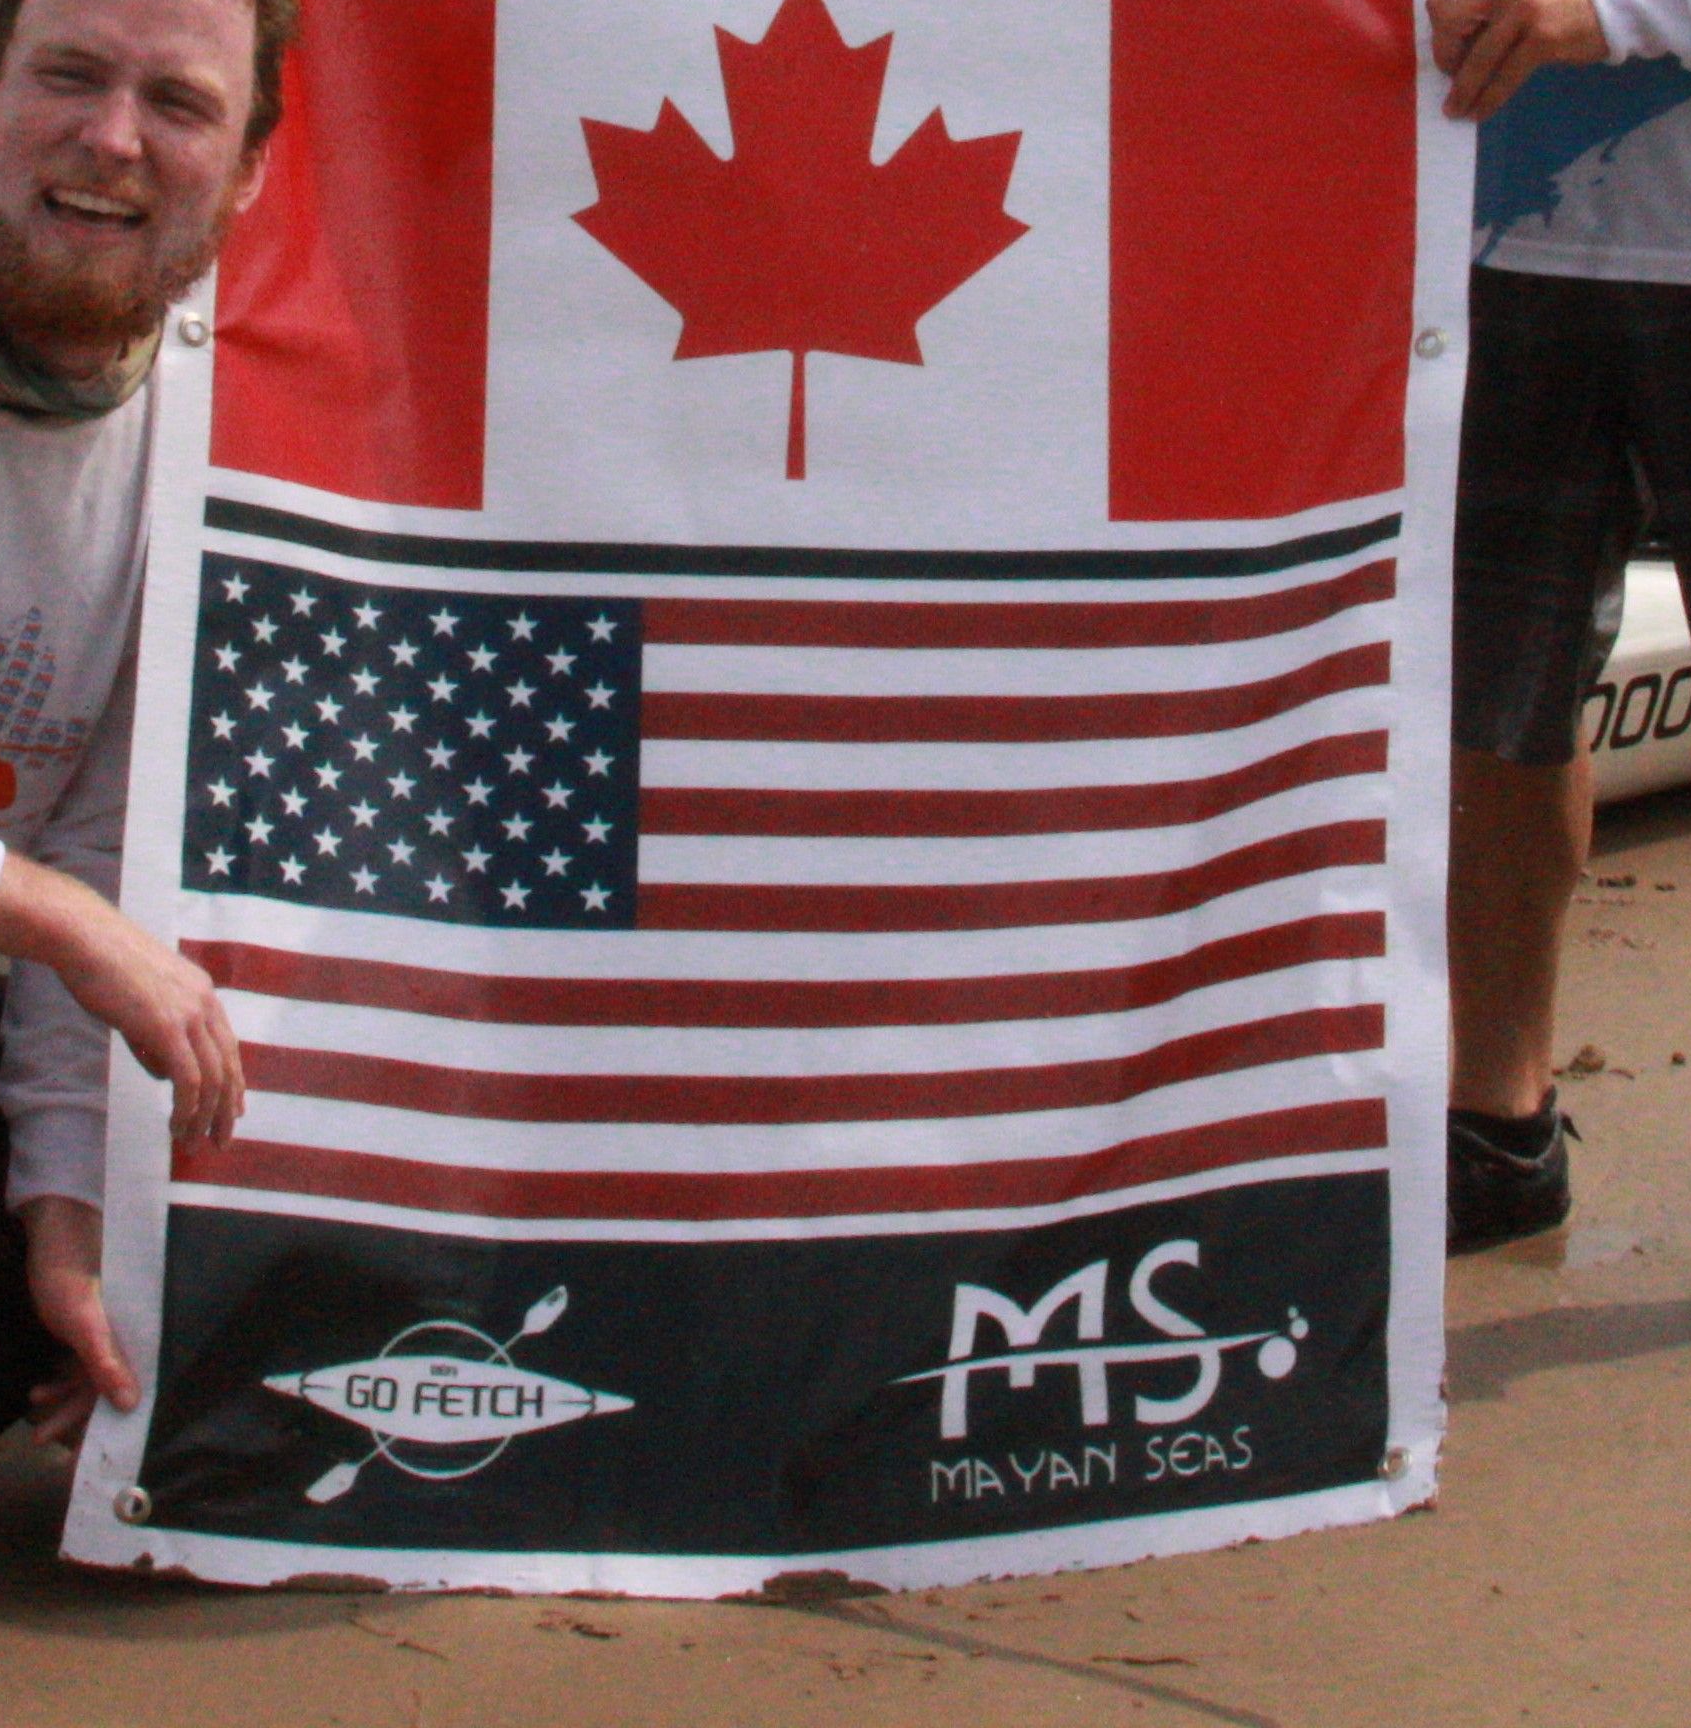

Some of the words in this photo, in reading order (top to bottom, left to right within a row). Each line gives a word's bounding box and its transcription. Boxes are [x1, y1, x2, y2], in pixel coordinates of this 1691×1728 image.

[939, 1238, 1222, 1440] MS
[345, 1373, 398, 1413] GO
[413, 1381, 544, 1418] FETCH
[931, 1442, 1117, 1504] MAYAN
[1145, 1424, 1254, 1482] SEAS
